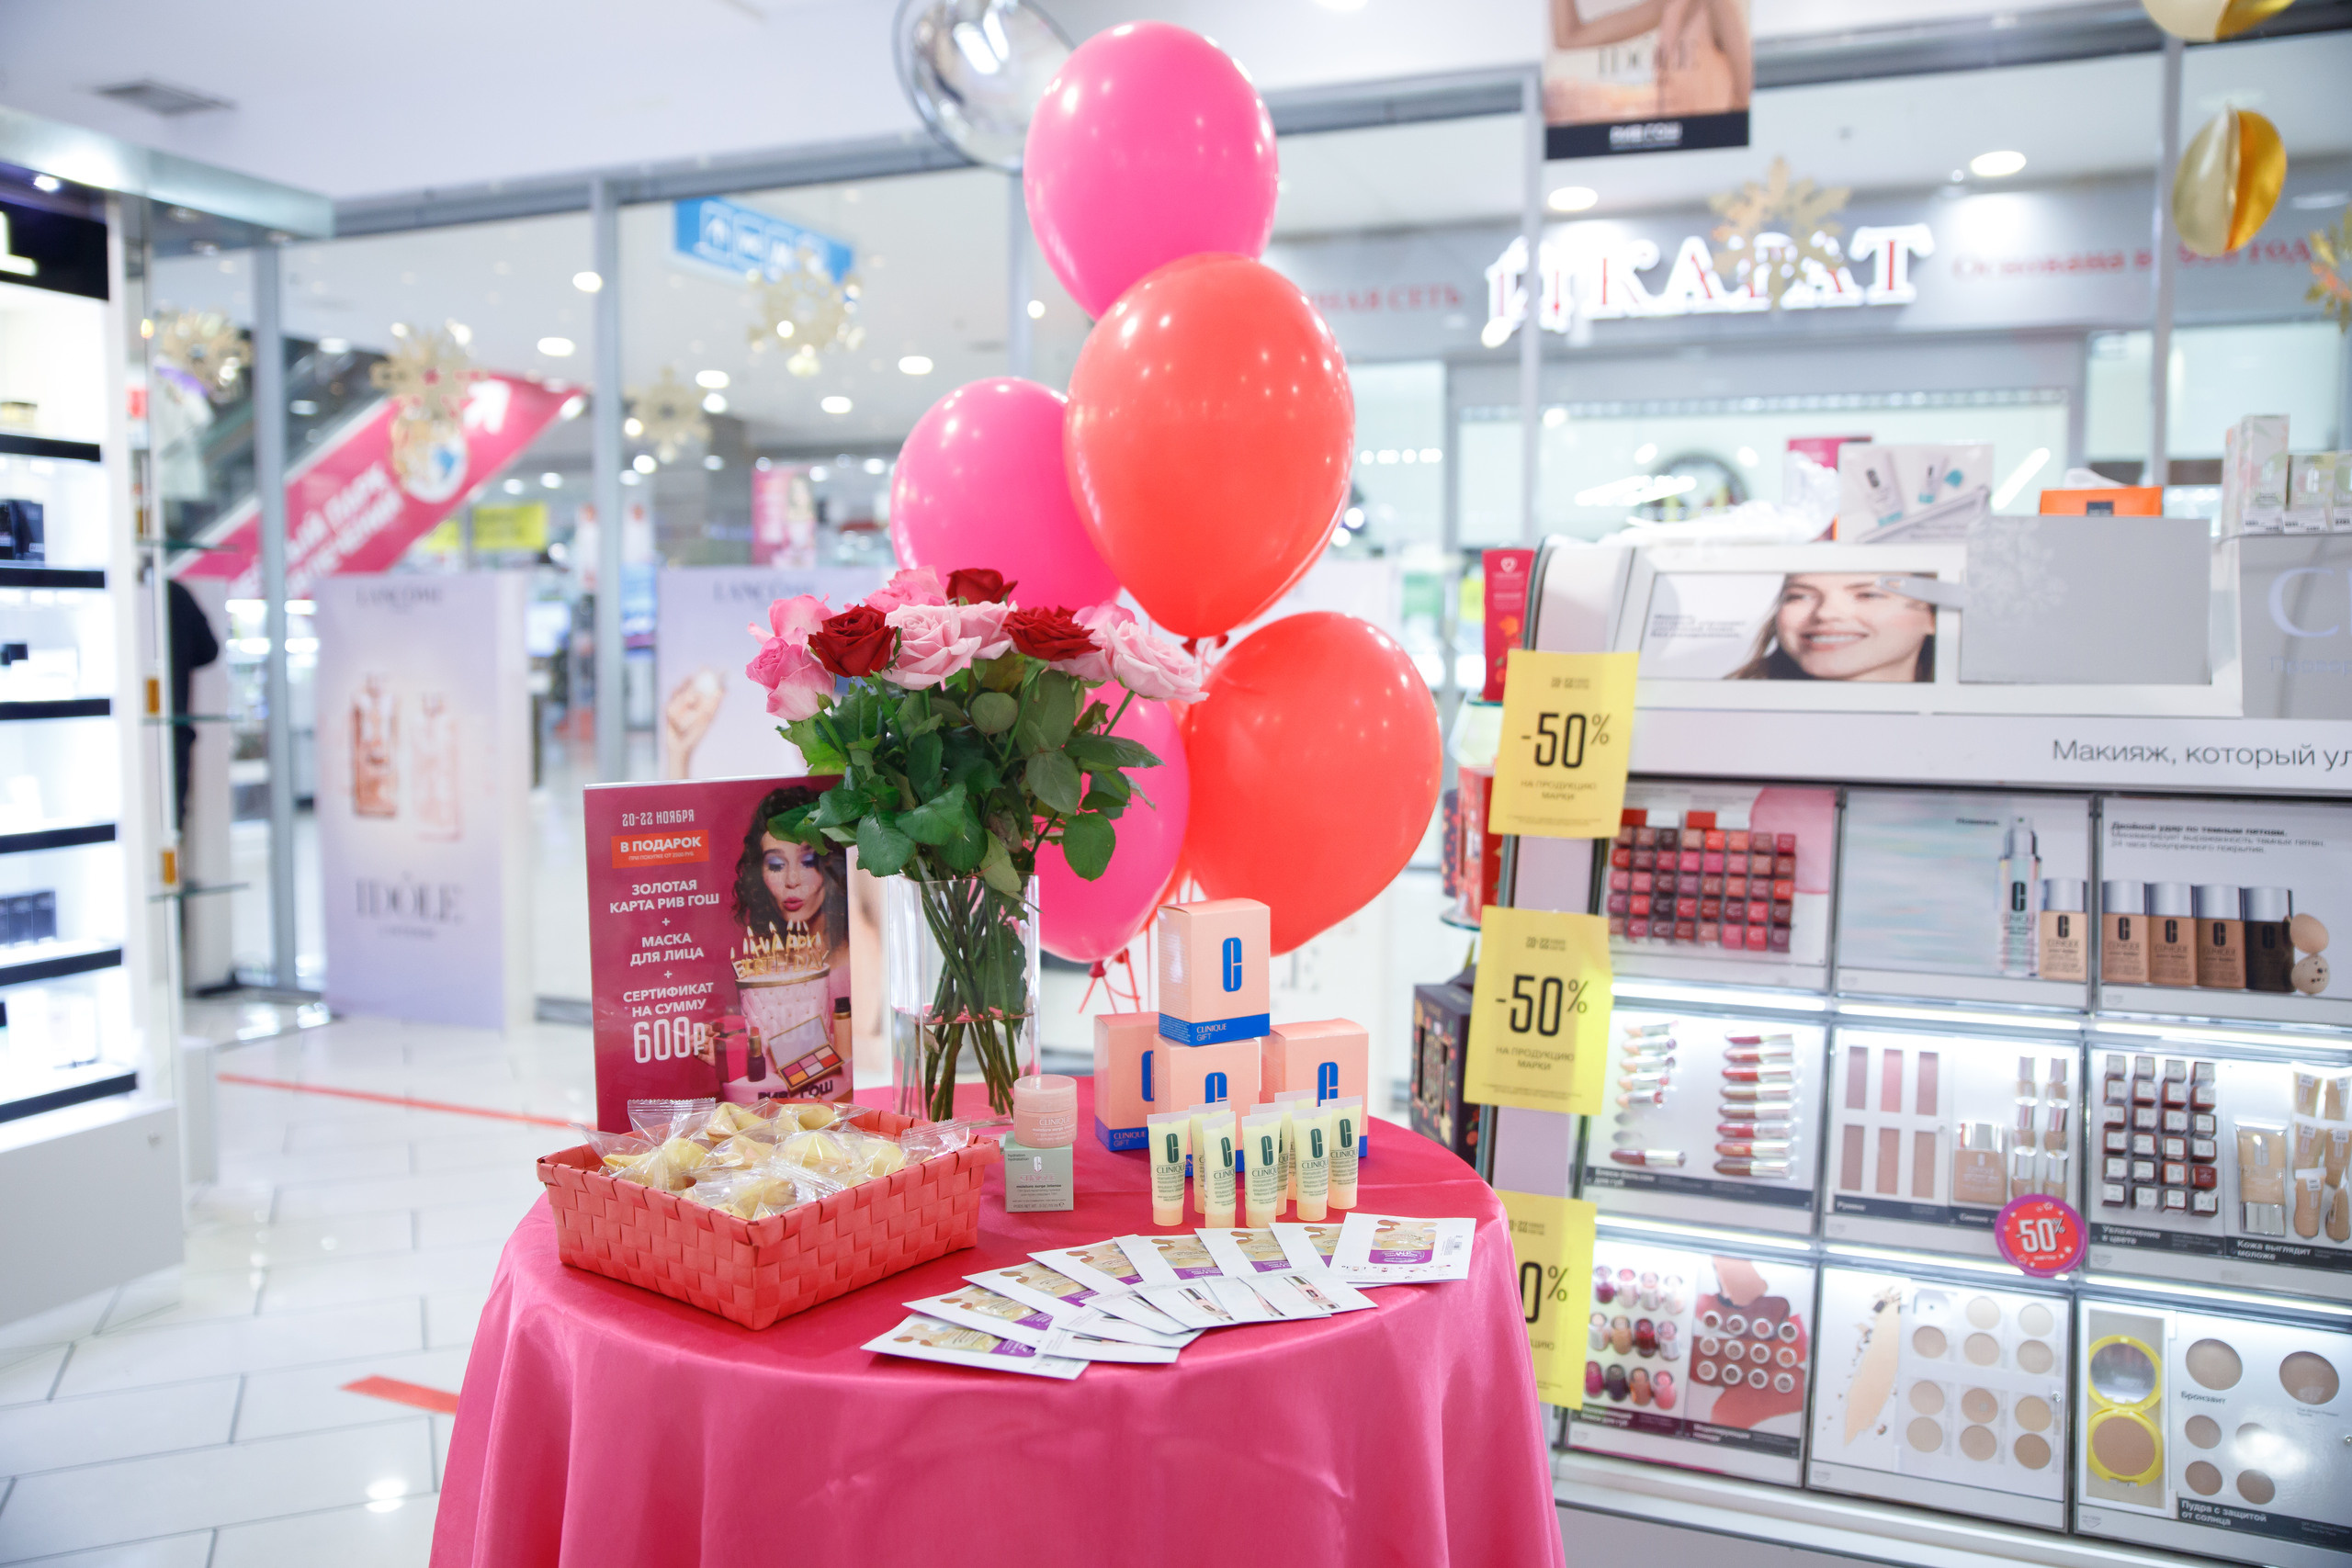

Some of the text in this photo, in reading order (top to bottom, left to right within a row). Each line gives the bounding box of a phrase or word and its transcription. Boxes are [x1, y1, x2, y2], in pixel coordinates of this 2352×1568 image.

[1521, 712, 1611, 768] -50%
[2052, 739, 2177, 765] Макияж,
[2187, 743, 2315, 770] который
[1542, 792, 1574, 801] МАРКИ
[622, 809, 695, 827] 20-22 НОЯБРЯ
[620, 836, 701, 852] В ПОДАРОК
[632, 880, 697, 896] ЗОЛОТАЯ
[610, 894, 719, 914] КАРТА РИВ ГОШ
[641, 933, 692, 948] МАСКА
[630, 947, 705, 966] ДЛЯ ЛИЦА
[623, 982, 714, 1003] СЕРТИФИКАТ
[632, 998, 707, 1018] НА СУММУ
[1496, 974, 1589, 1036] -50%
[1196, 1022, 1227, 1033] CLINIQUE
[1196, 1032, 1212, 1042] GIFT
[1496, 1045, 1575, 1062] НА ПРОДУКЦИЮ
[1518, 1059, 1551, 1071] МАРКИ
[1039, 1115, 1071, 1126] CLINIQUE
[1114, 1131, 1146, 1140] CLINIQUE
[1114, 1139, 1129, 1147] GIFT
[2015, 1218, 2066, 1254] -50%
[2102, 1224, 2161, 1239] Увлажнение
[2237, 1239, 2263, 1250] Кожа
[2265, 1244, 2312, 1256] выглядит
[2237, 1250, 2276, 1261] моложе
[2181, 1500, 2212, 1514] Пудра
[2222, 1508, 2267, 1522] защитой
[2181, 1511, 2232, 1526] от солнца
